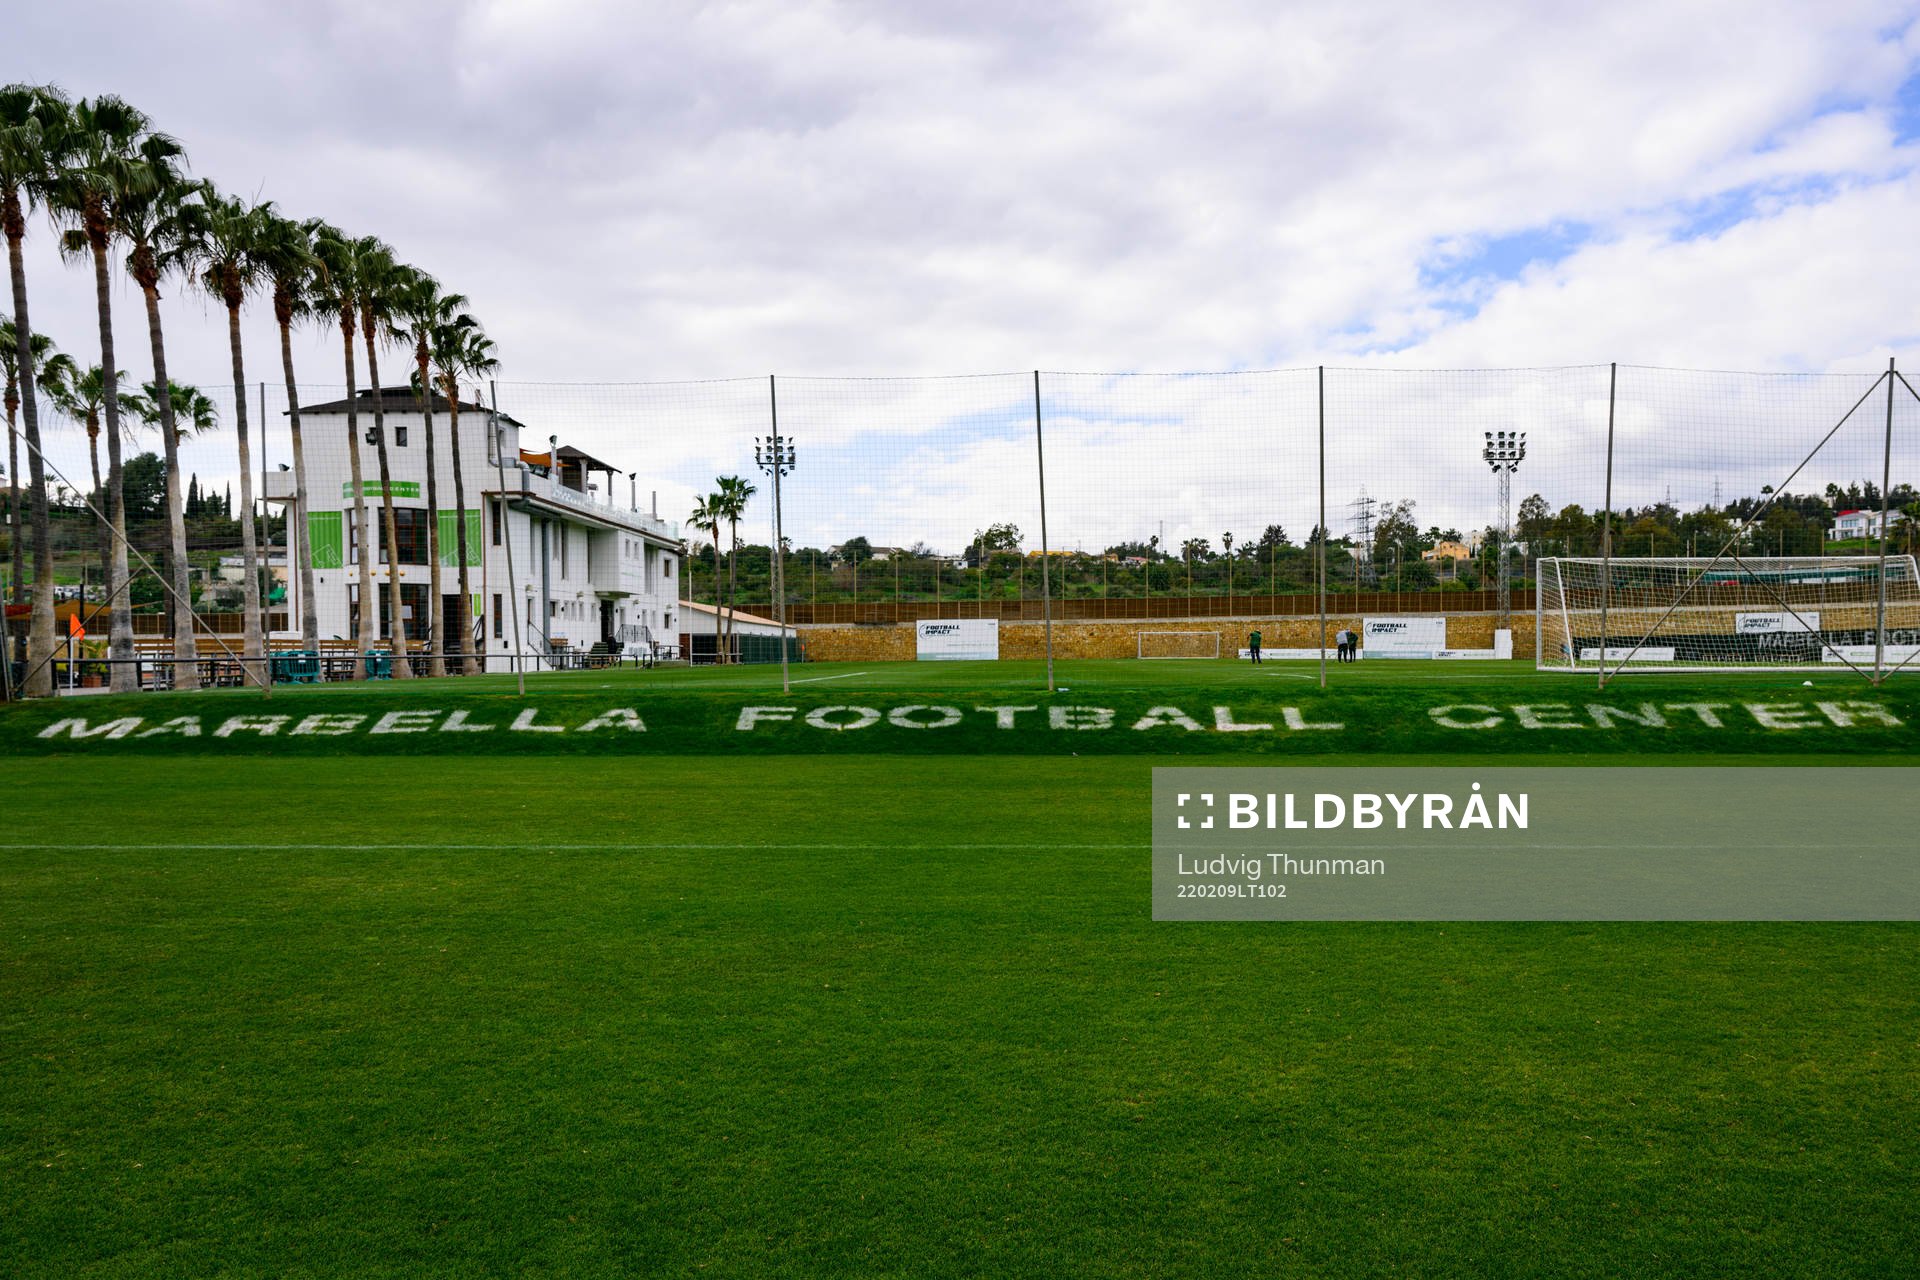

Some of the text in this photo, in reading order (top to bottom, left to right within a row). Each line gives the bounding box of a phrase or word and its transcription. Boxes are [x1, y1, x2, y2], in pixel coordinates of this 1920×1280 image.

[37, 701, 1905, 739] MARBELLA FOOTBALL CENTER
